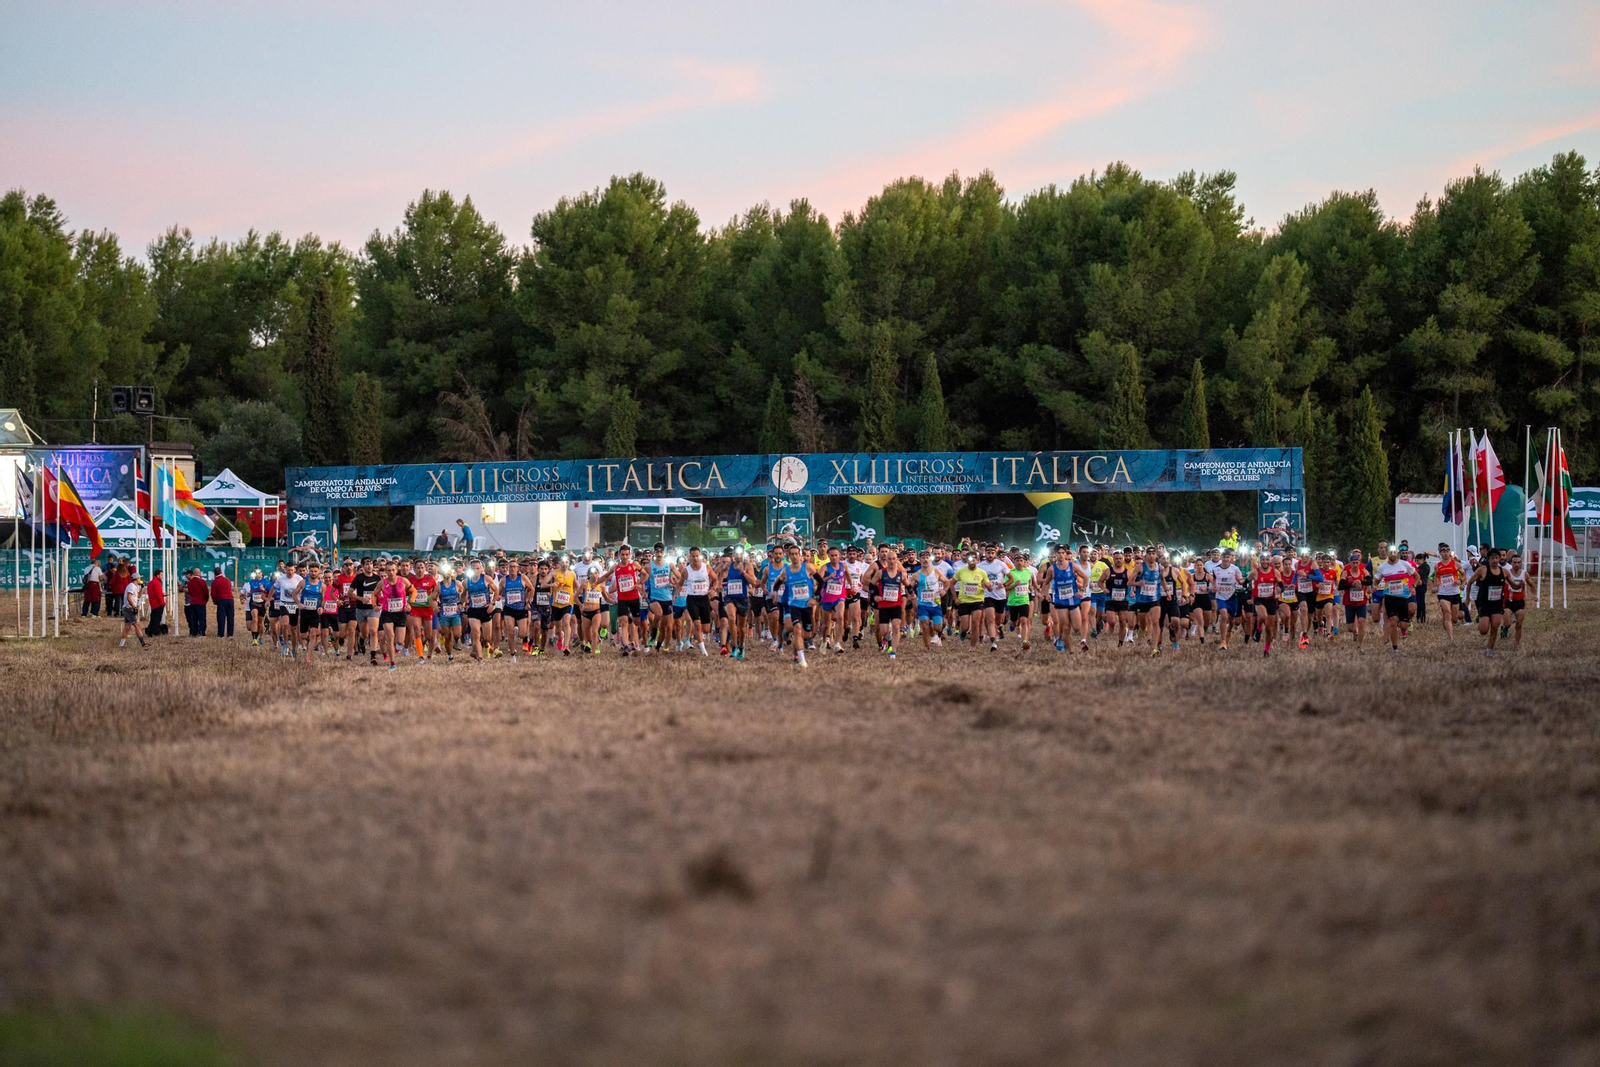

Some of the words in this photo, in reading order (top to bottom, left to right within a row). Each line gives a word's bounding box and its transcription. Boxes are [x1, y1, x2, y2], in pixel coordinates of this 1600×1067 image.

[991, 451, 1134, 485] ITÁLICA
[1247, 460, 1291, 468] ANDALUCÍA
[586, 458, 728, 493] ITÁLICA
[829, 459, 905, 485] XLIII
[905, 458, 964, 474] CROSS
[1247, 466, 1276, 475] TRAVÉS
[294, 479, 344, 487] CAMPEONATO
[355, 477, 398, 485] ANDALUCÍA
[427, 468, 500, 495] XLIII
[502, 467, 560, 483] CROSS
[905, 474, 985, 484] INTERNACIONAL
[320, 485, 347, 493] CAMPO
[355, 484, 382, 492] TRAVÉS
[502, 482, 581, 493] INTERNACIONAL
[828, 485, 900, 494] INTERNATIONAL
[901, 484, 929, 493] CROSS
[930, 484, 972, 493] COUNTRY
[342, 491, 368, 499] CLUBES
[426, 494, 497, 504] INTERNATIONAL
[498, 493, 524, 502] CROSS
[525, 492, 568, 501] COUNTRY
